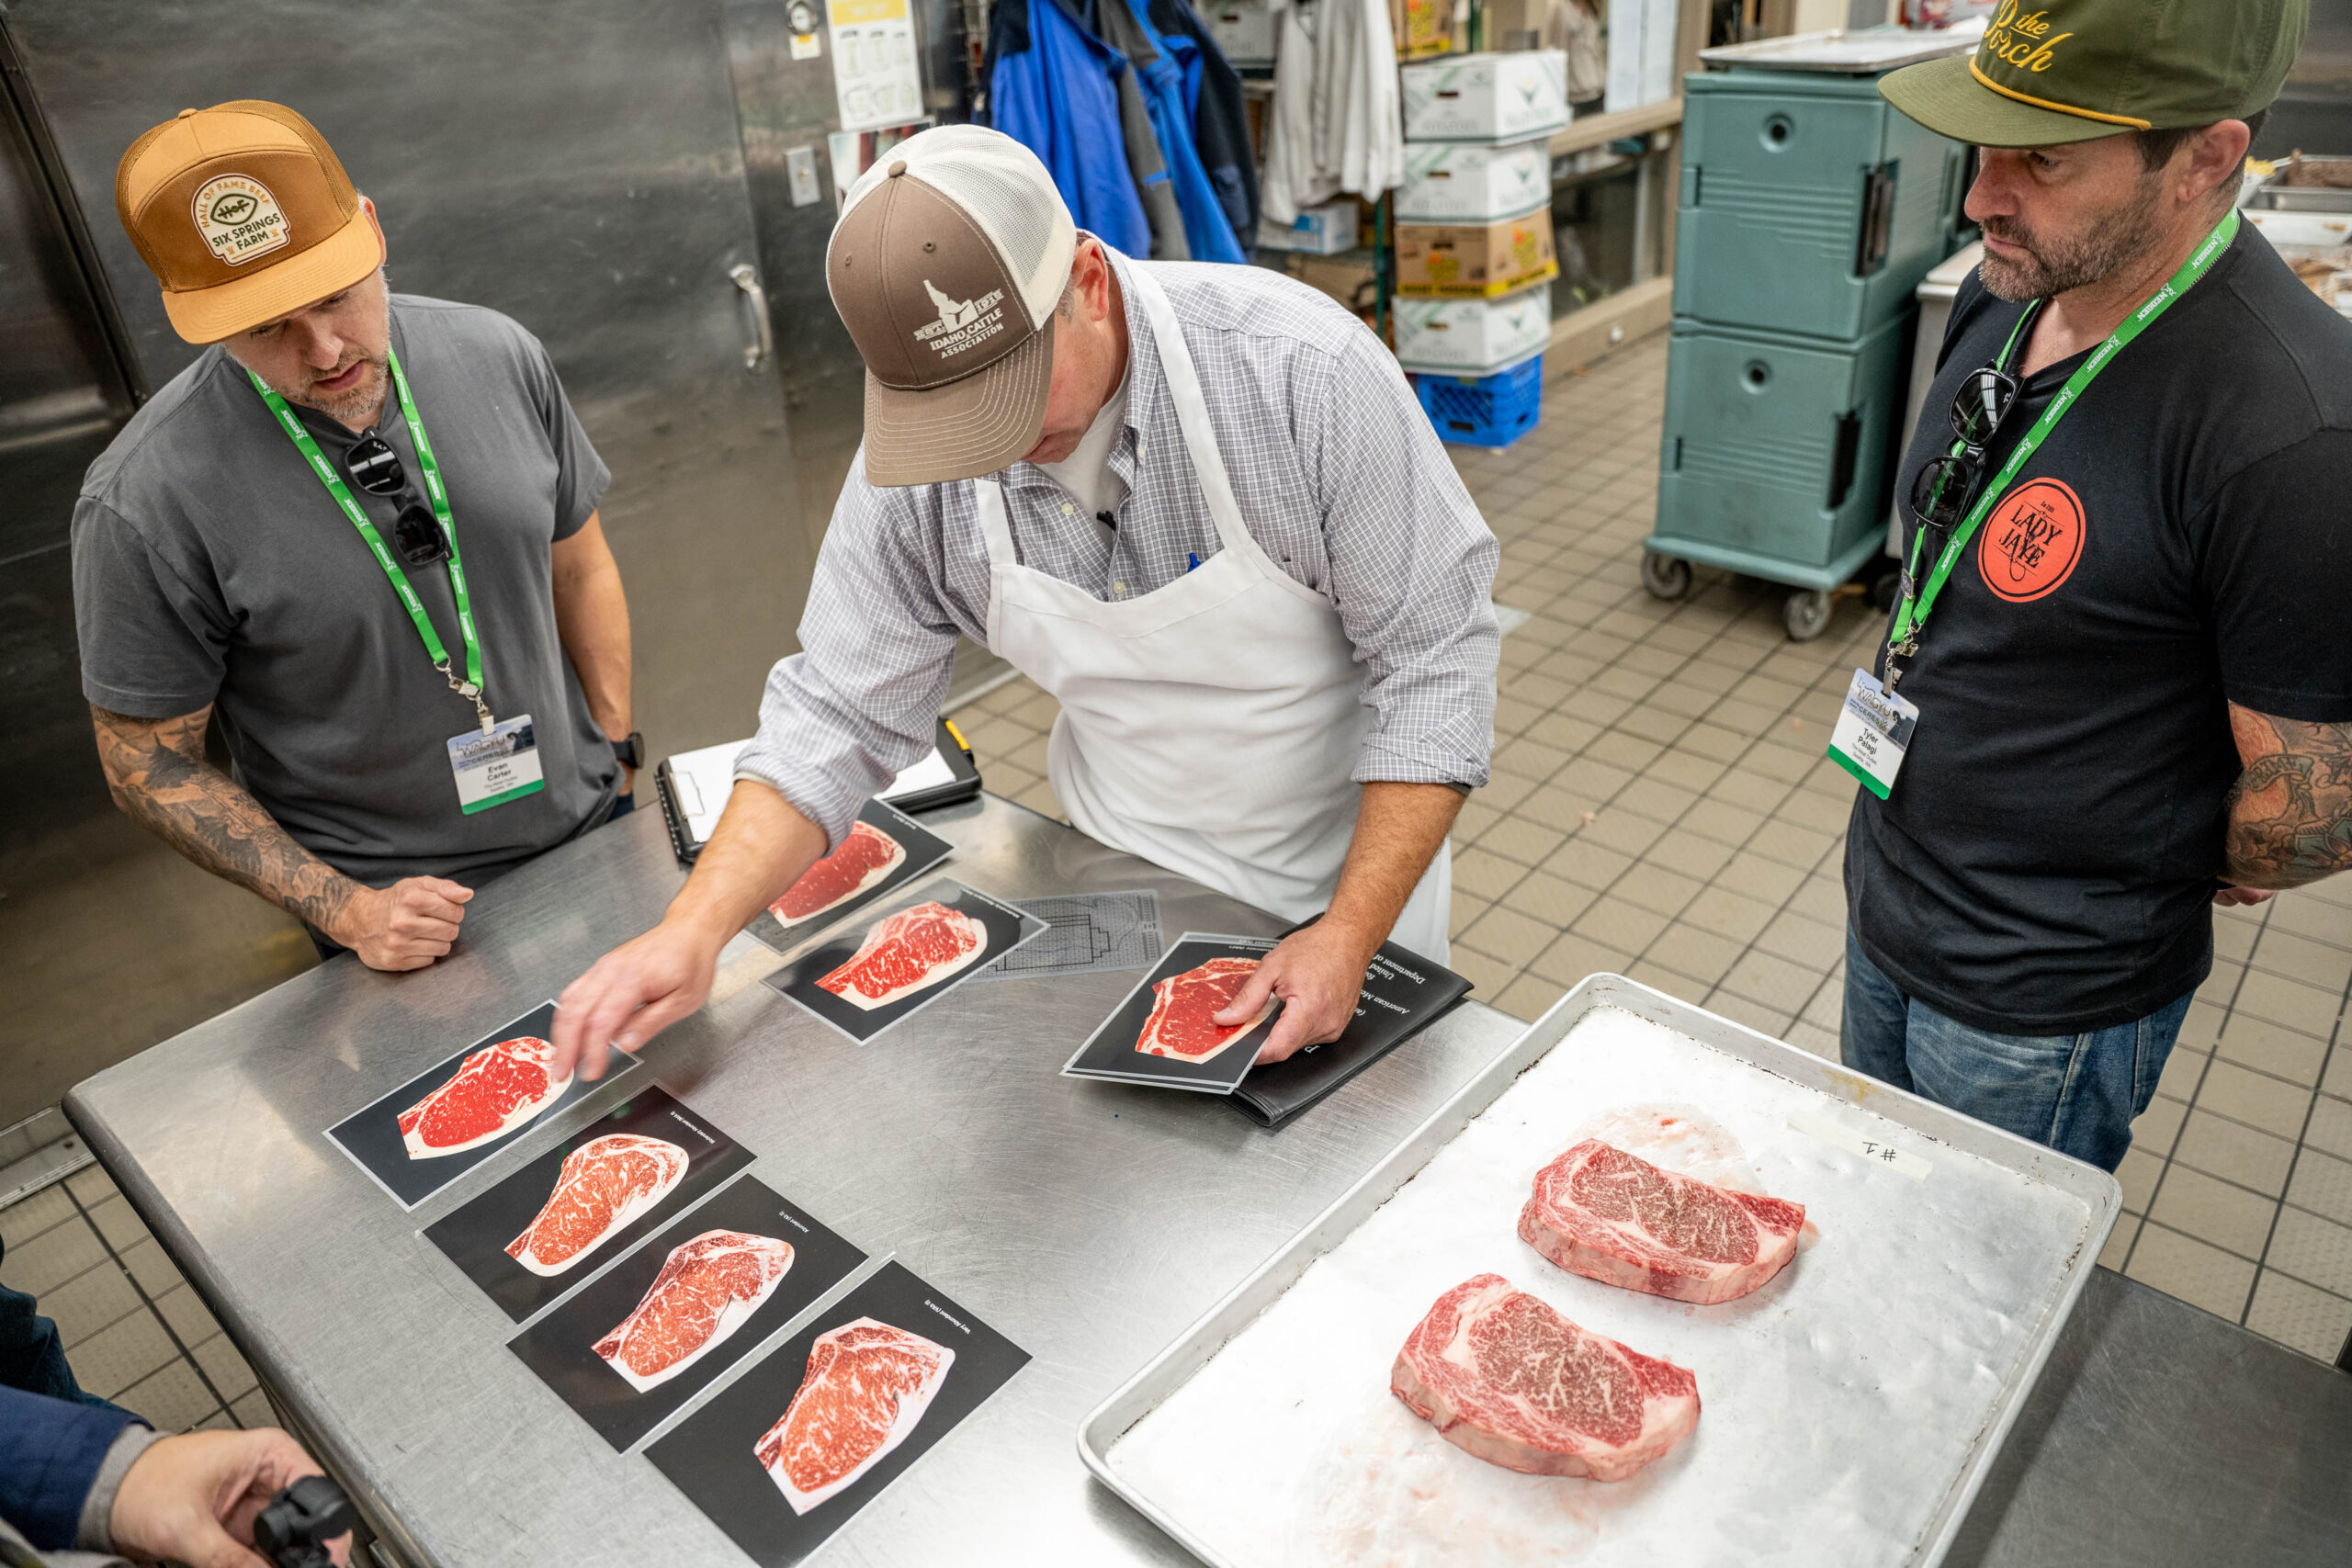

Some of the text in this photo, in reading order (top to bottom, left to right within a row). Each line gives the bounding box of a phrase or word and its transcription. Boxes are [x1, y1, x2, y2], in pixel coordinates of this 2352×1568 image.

[1984, 0, 2074, 73] Porch
[2015, 11, 2050, 35] the
[198, 180, 270, 228] HALL OF FAME BEEF
[212, 213, 280, 246] SIX SPRINGS
[235, 231, 269, 250] FARM
[2192, 239, 2219, 269] NEOGEN
[2137, 292, 2168, 321] NEOGEN
[930, 308, 1003, 351] IDAHO CATTLE
[941, 322, 1003, 359] ASSOCIATION
[2087, 343, 2114, 371] NEOGEN
[2045, 395, 2067, 424] NEOGEN
[2010, 505, 2063, 546] LADY
[1999, 527, 2046, 570] JAYE
[1858, 737, 1876, 755] Palagi
[1863, 728, 1878, 744] Tyler
[487, 770, 511, 781] Carter
[488, 762, 507, 773] Evan
[1368, 963, 1395, 980] United
[1373, 953, 1426, 985] Department of
[1374, 996, 1410, 1015] American
[939, 1310, 961, 1327] Abundant
[958, 1323, 971, 1334] Very
